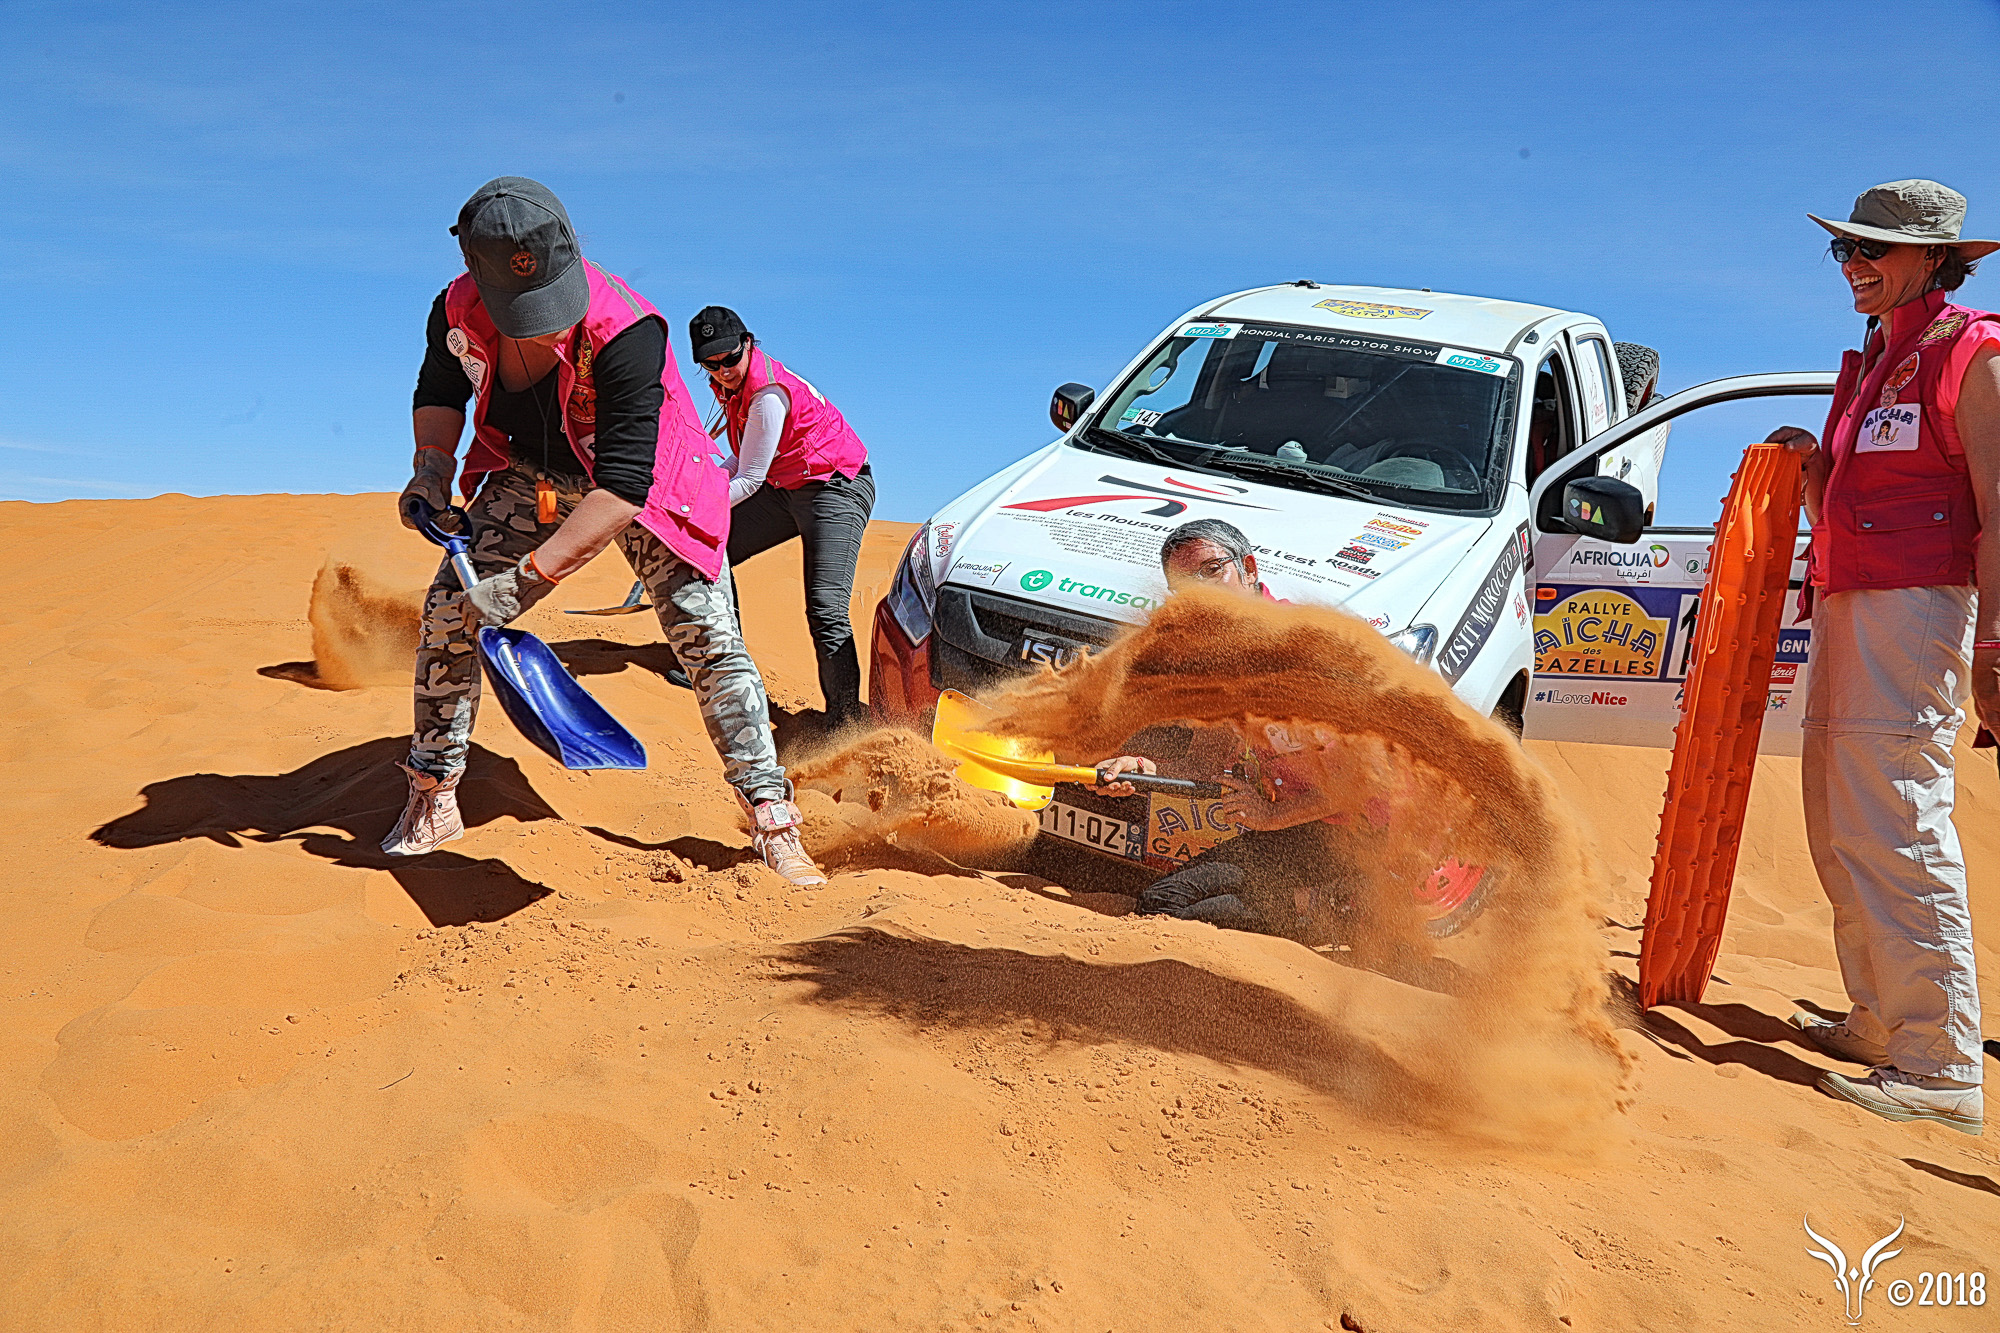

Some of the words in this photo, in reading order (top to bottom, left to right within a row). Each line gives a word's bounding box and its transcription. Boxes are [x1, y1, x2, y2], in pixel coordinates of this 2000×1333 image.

[1189, 327, 1226, 335] MDJS
[1238, 328, 1291, 339] MONDIAL
[1295, 333, 1336, 344] PARIS
[1339, 338, 1389, 350] MOTOR
[1393, 345, 1438, 357] SHOW
[1451, 355, 1496, 371] MDJS
[1135, 410, 1162, 426] 147
[1066, 509, 1096, 520] Les
[1571, 550, 1652, 568] AFRIQUIA
[955, 563, 992, 572] AFRIQUIA
[1325, 558, 1381, 577] Roady
[1440, 620, 1480, 676] VISIT
[1471, 552, 1513, 628] MOROCCO
[1567, 601, 1631, 616] RALLYE
[1582, 646, 1602, 656] des
[1534, 657, 1655, 675] GAZELLES
[1535, 690, 1628, 706] #ILoveNice
[1126, 841, 1142, 856] 73
